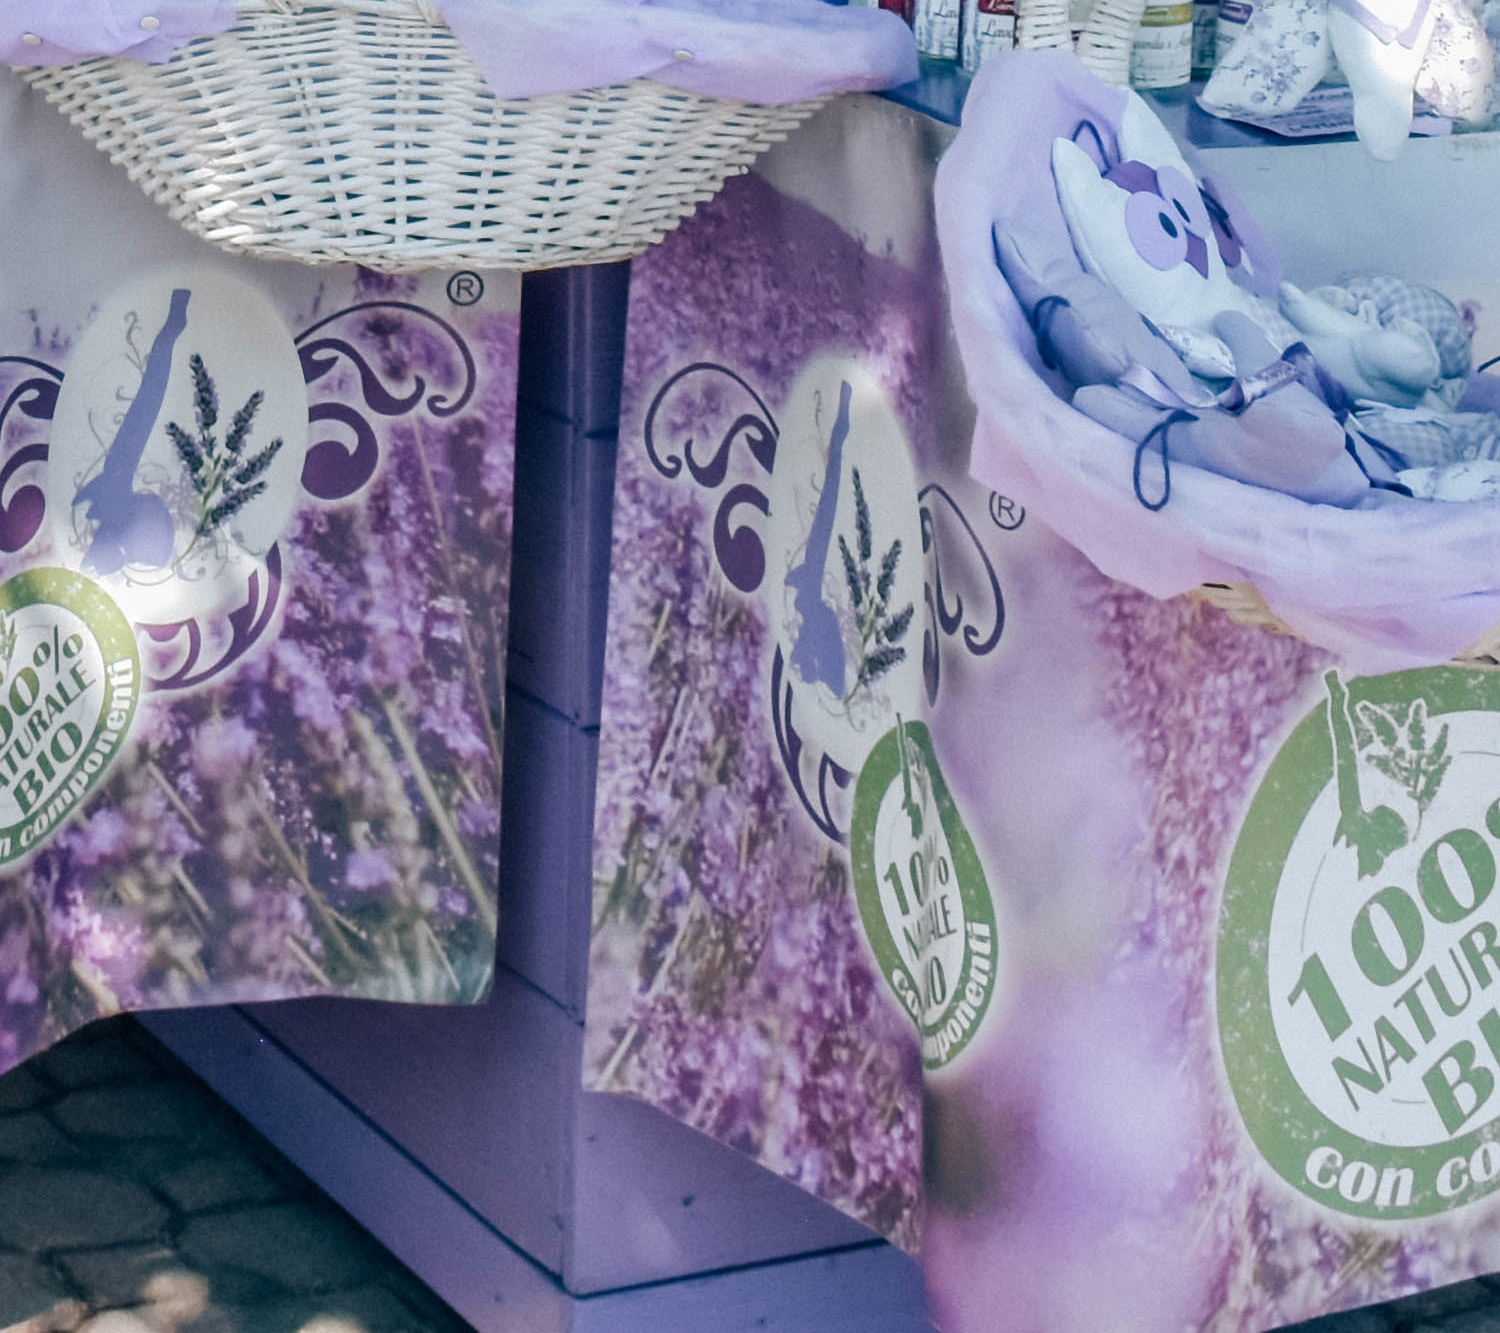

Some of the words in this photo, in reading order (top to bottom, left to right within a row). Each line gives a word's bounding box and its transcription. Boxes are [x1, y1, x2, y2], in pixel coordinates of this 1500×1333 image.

[13, 721, 83, 816] BIO
[19, 658, 134, 847] componenti
[1305, 1145, 1413, 1207] con
